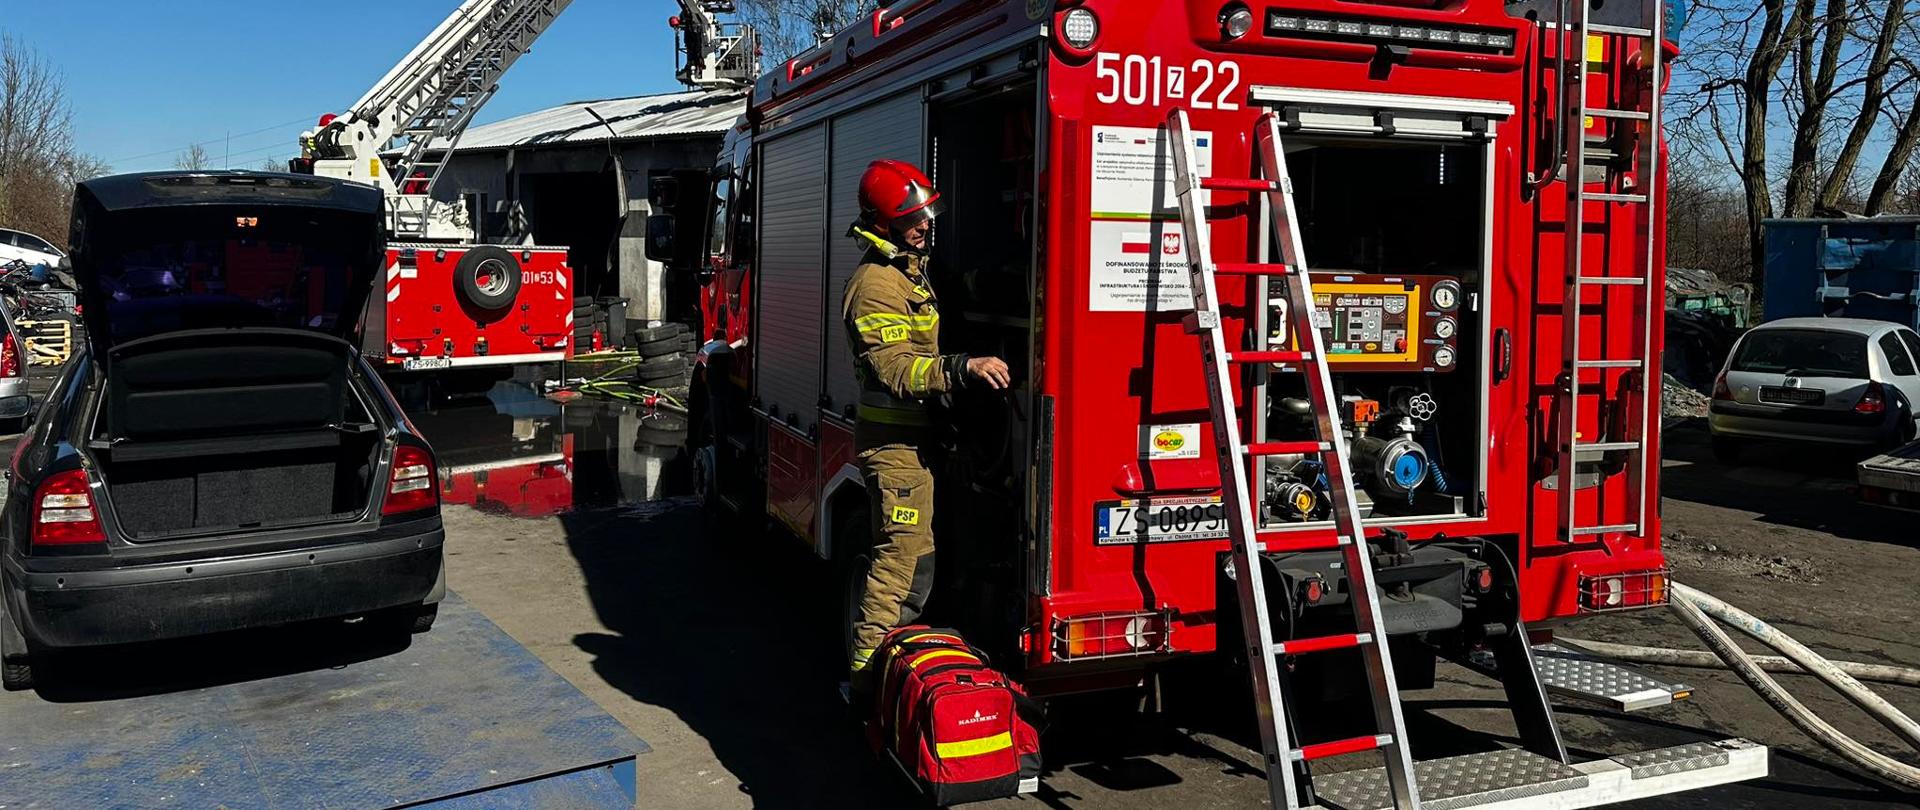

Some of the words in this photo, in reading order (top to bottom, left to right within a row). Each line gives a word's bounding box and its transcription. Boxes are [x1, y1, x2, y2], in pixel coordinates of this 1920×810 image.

[1096, 52, 1161, 106] 501
[1170, 69, 1182, 95] Z
[1190, 59, 1240, 110] 22
[1166, 260, 1190, 268] ŚRODKÓ
[540, 271, 554, 284] 53
[885, 327, 904, 340] PSP
[1157, 437, 1183, 446] bocar
[896, 509, 915, 521] PSP
[1116, 508, 1149, 535] ZS
[1099, 526, 1109, 534] PL
